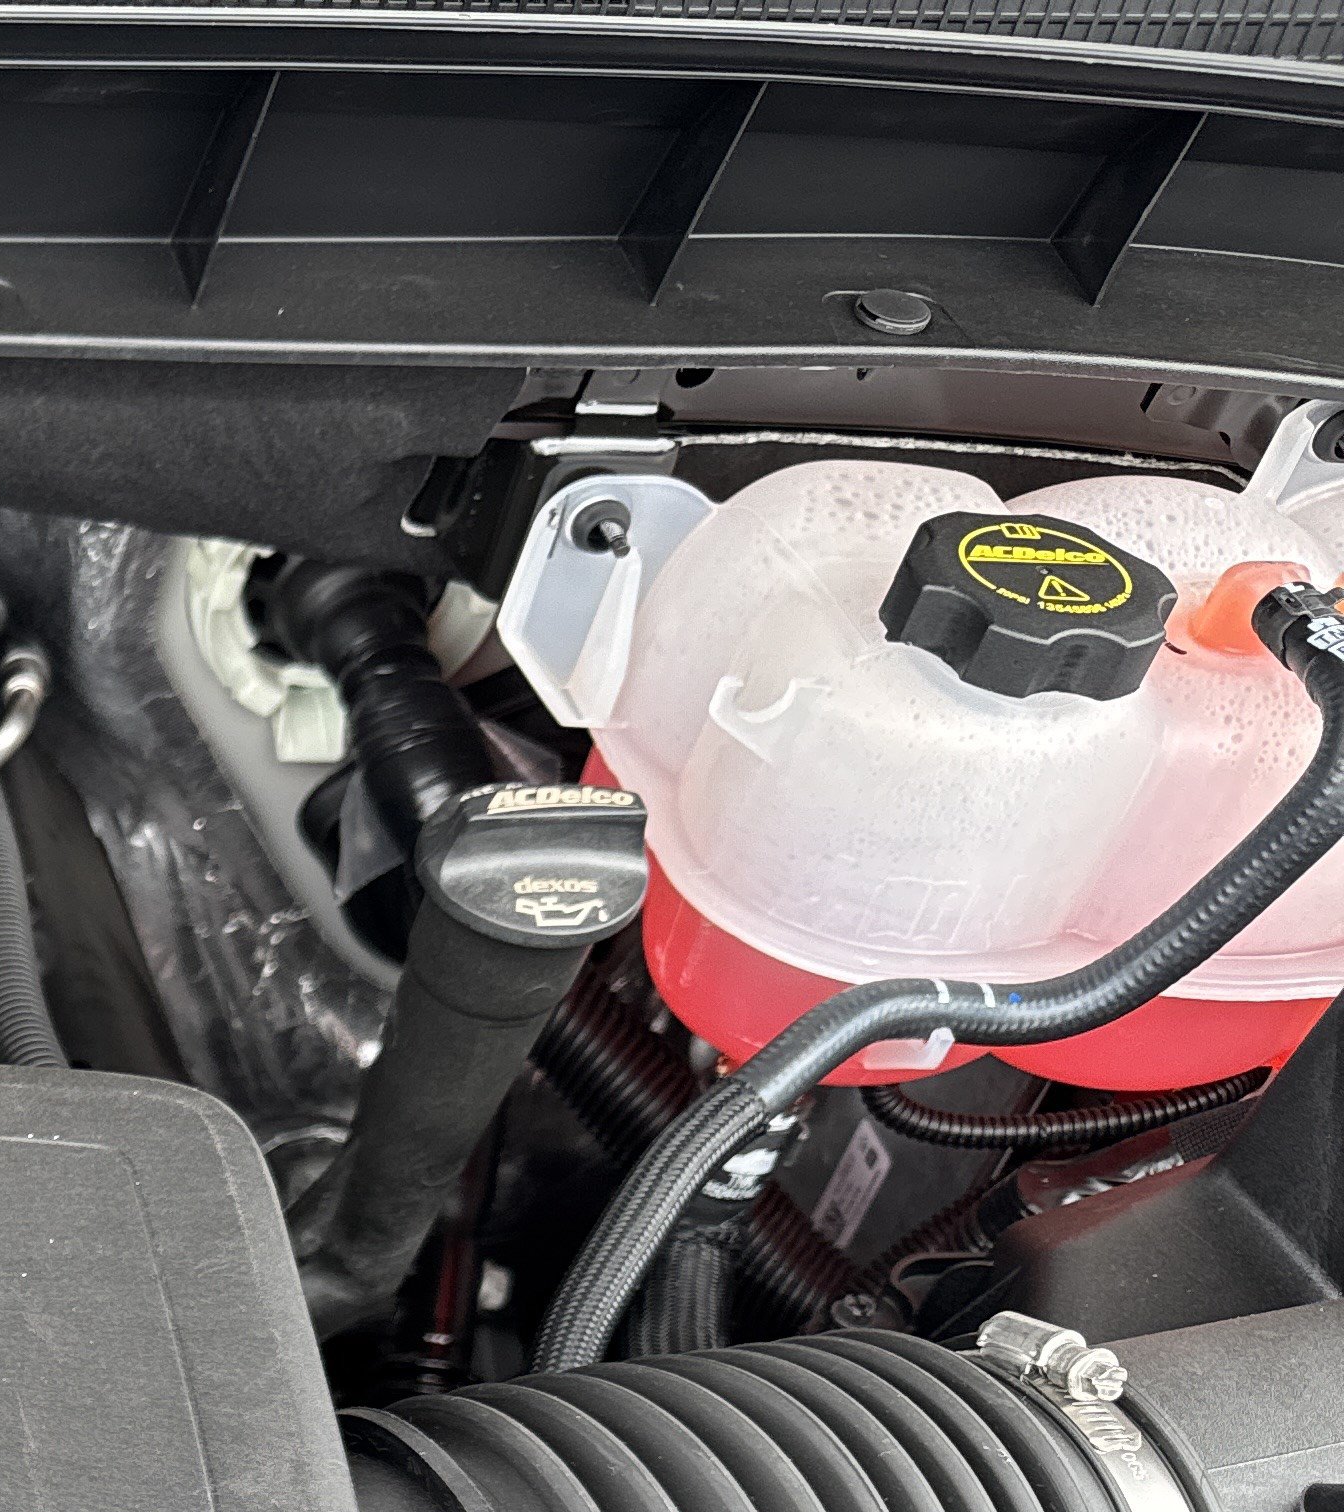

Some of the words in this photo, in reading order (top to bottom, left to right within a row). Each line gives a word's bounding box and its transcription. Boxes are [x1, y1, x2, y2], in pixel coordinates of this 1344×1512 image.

[968, 544, 1106, 563] ACDelco
[486, 786, 634, 811] ACDelco
[513, 876, 599, 894] dexos
